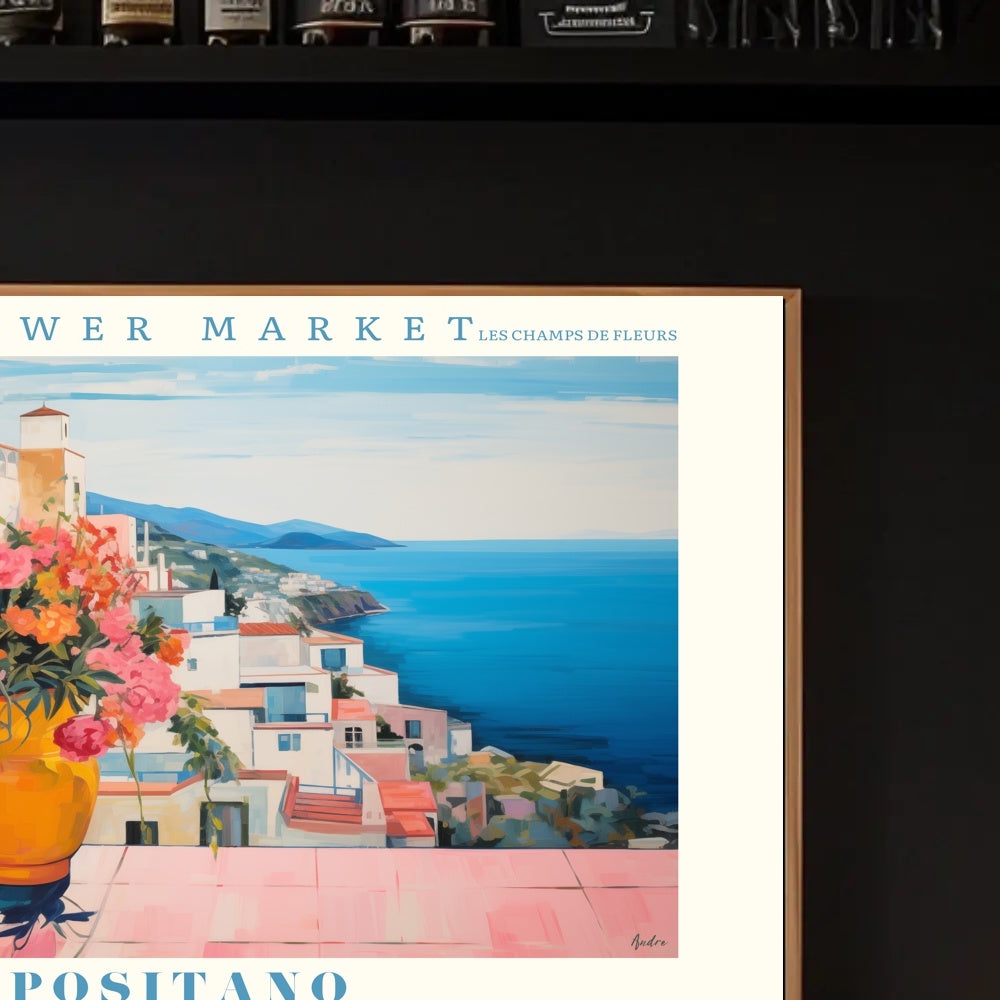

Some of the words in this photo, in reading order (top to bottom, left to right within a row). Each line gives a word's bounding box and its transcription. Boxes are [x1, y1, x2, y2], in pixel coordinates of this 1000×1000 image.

[201, 316, 474, 342] MARKET
[478, 329, 508, 342] LES
[511, 329, 583, 342] CHAMPS
[588, 329, 609, 342] DE
[613, 329, 678, 342] FLEURS
[631, 933, 668, 951] Andre
